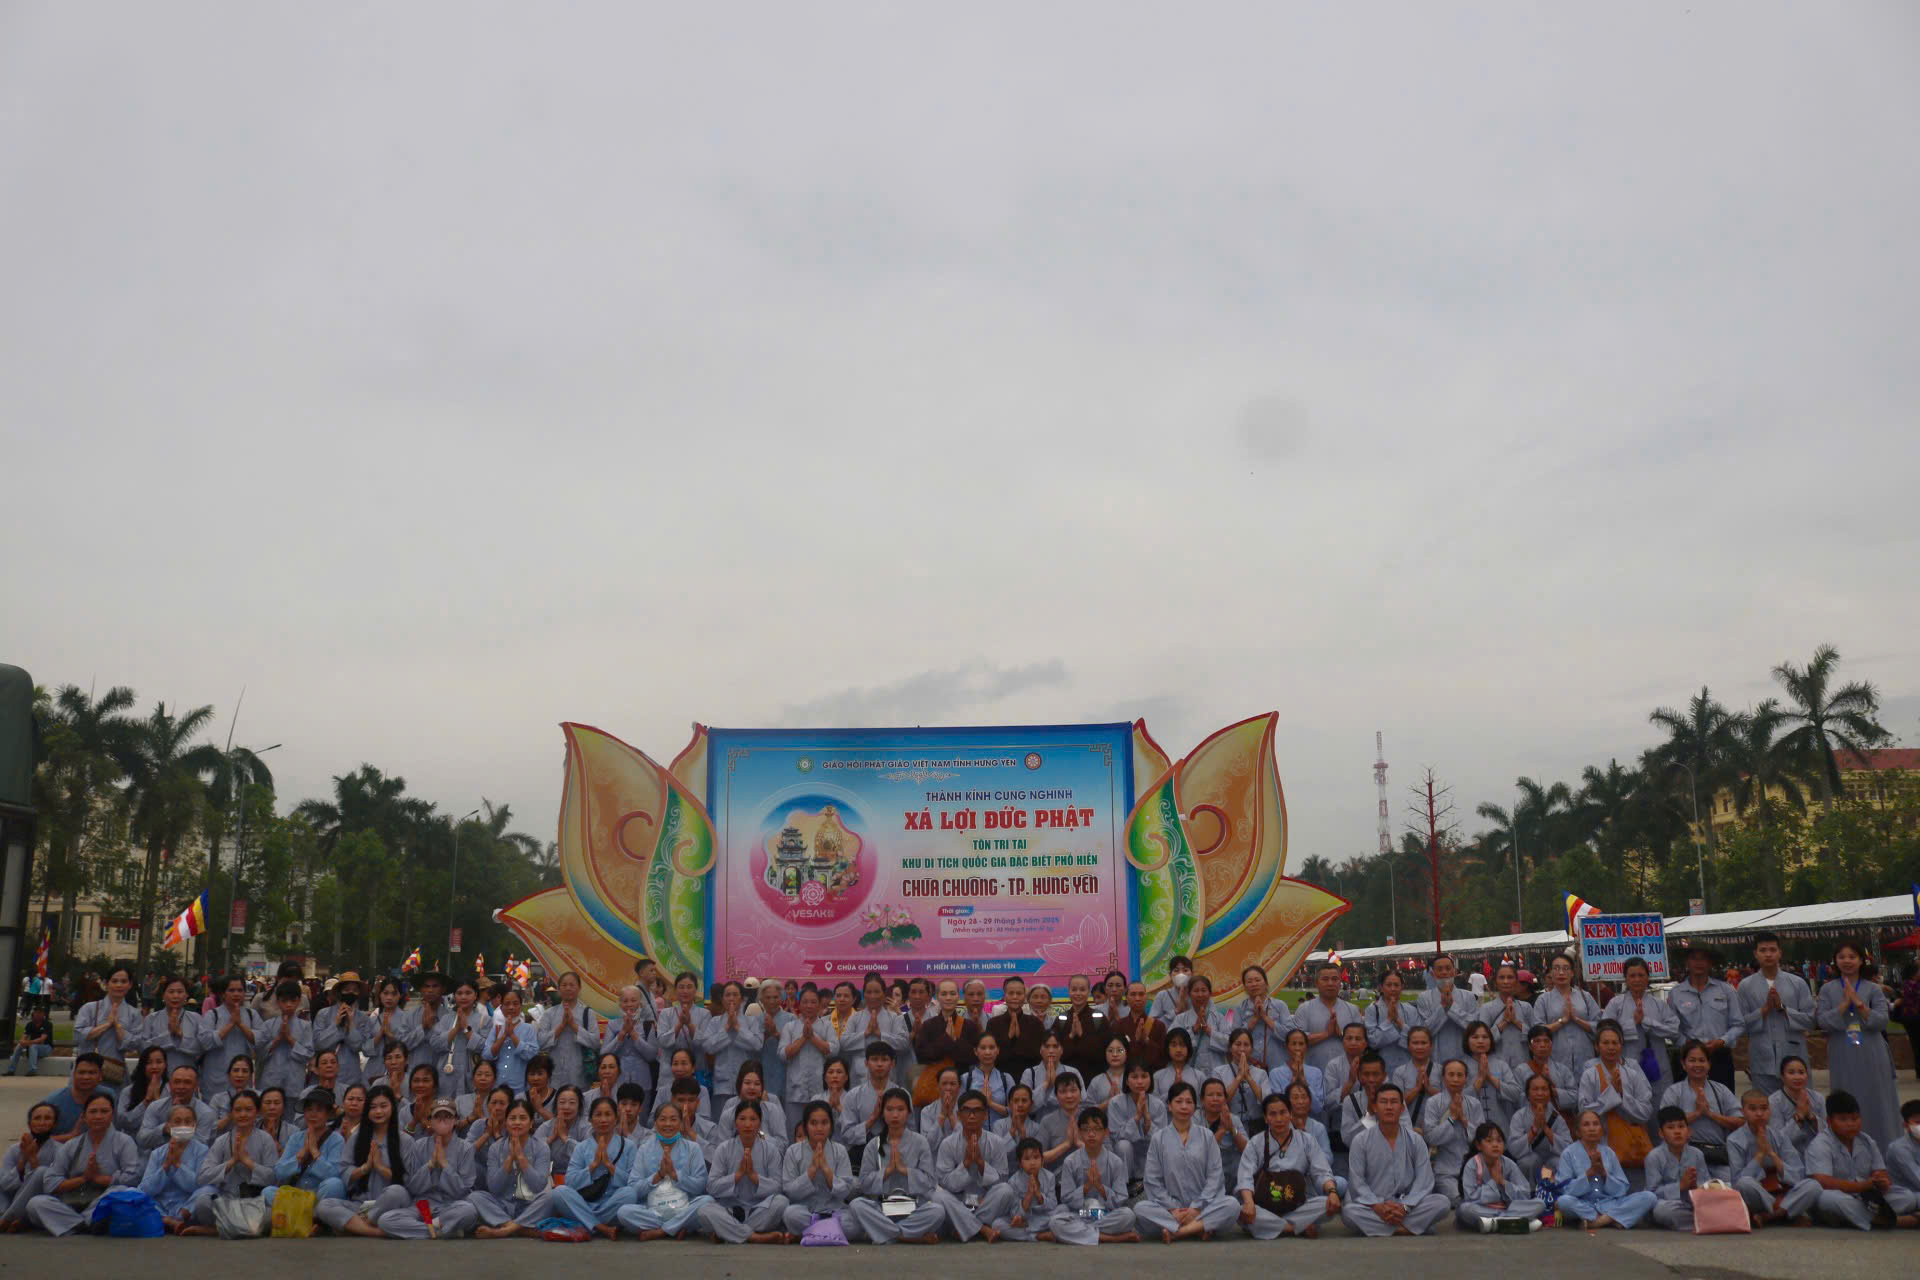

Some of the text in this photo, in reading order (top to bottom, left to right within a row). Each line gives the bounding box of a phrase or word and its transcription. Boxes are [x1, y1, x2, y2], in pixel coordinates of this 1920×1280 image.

[926, 788, 1073, 802] THÀNH KÍNH CUNG NGHINH
[904, 804, 1095, 834] XÁ LỢI ĐỨC PHẬT
[973, 838, 991, 850] TÔN
[902, 851, 1098, 869] KHU DI TÍCH QUỐC GIA ĐẶC BIỆT PHỐ HIẾN
[902, 878, 940, 897] CHÙA
[942, 876, 998, 897] CHUÔNG
[1008, 877, 1030, 896] TP.
[1032, 876, 1070, 896] HƯNG
[1072, 874, 1099, 895] YÊN
[947, 918, 967, 926] Ngày
[1584, 923, 1617, 938] KEM
[1617, 941, 1646, 956] ĐỒNG
[1648, 943, 1662, 955] XU
